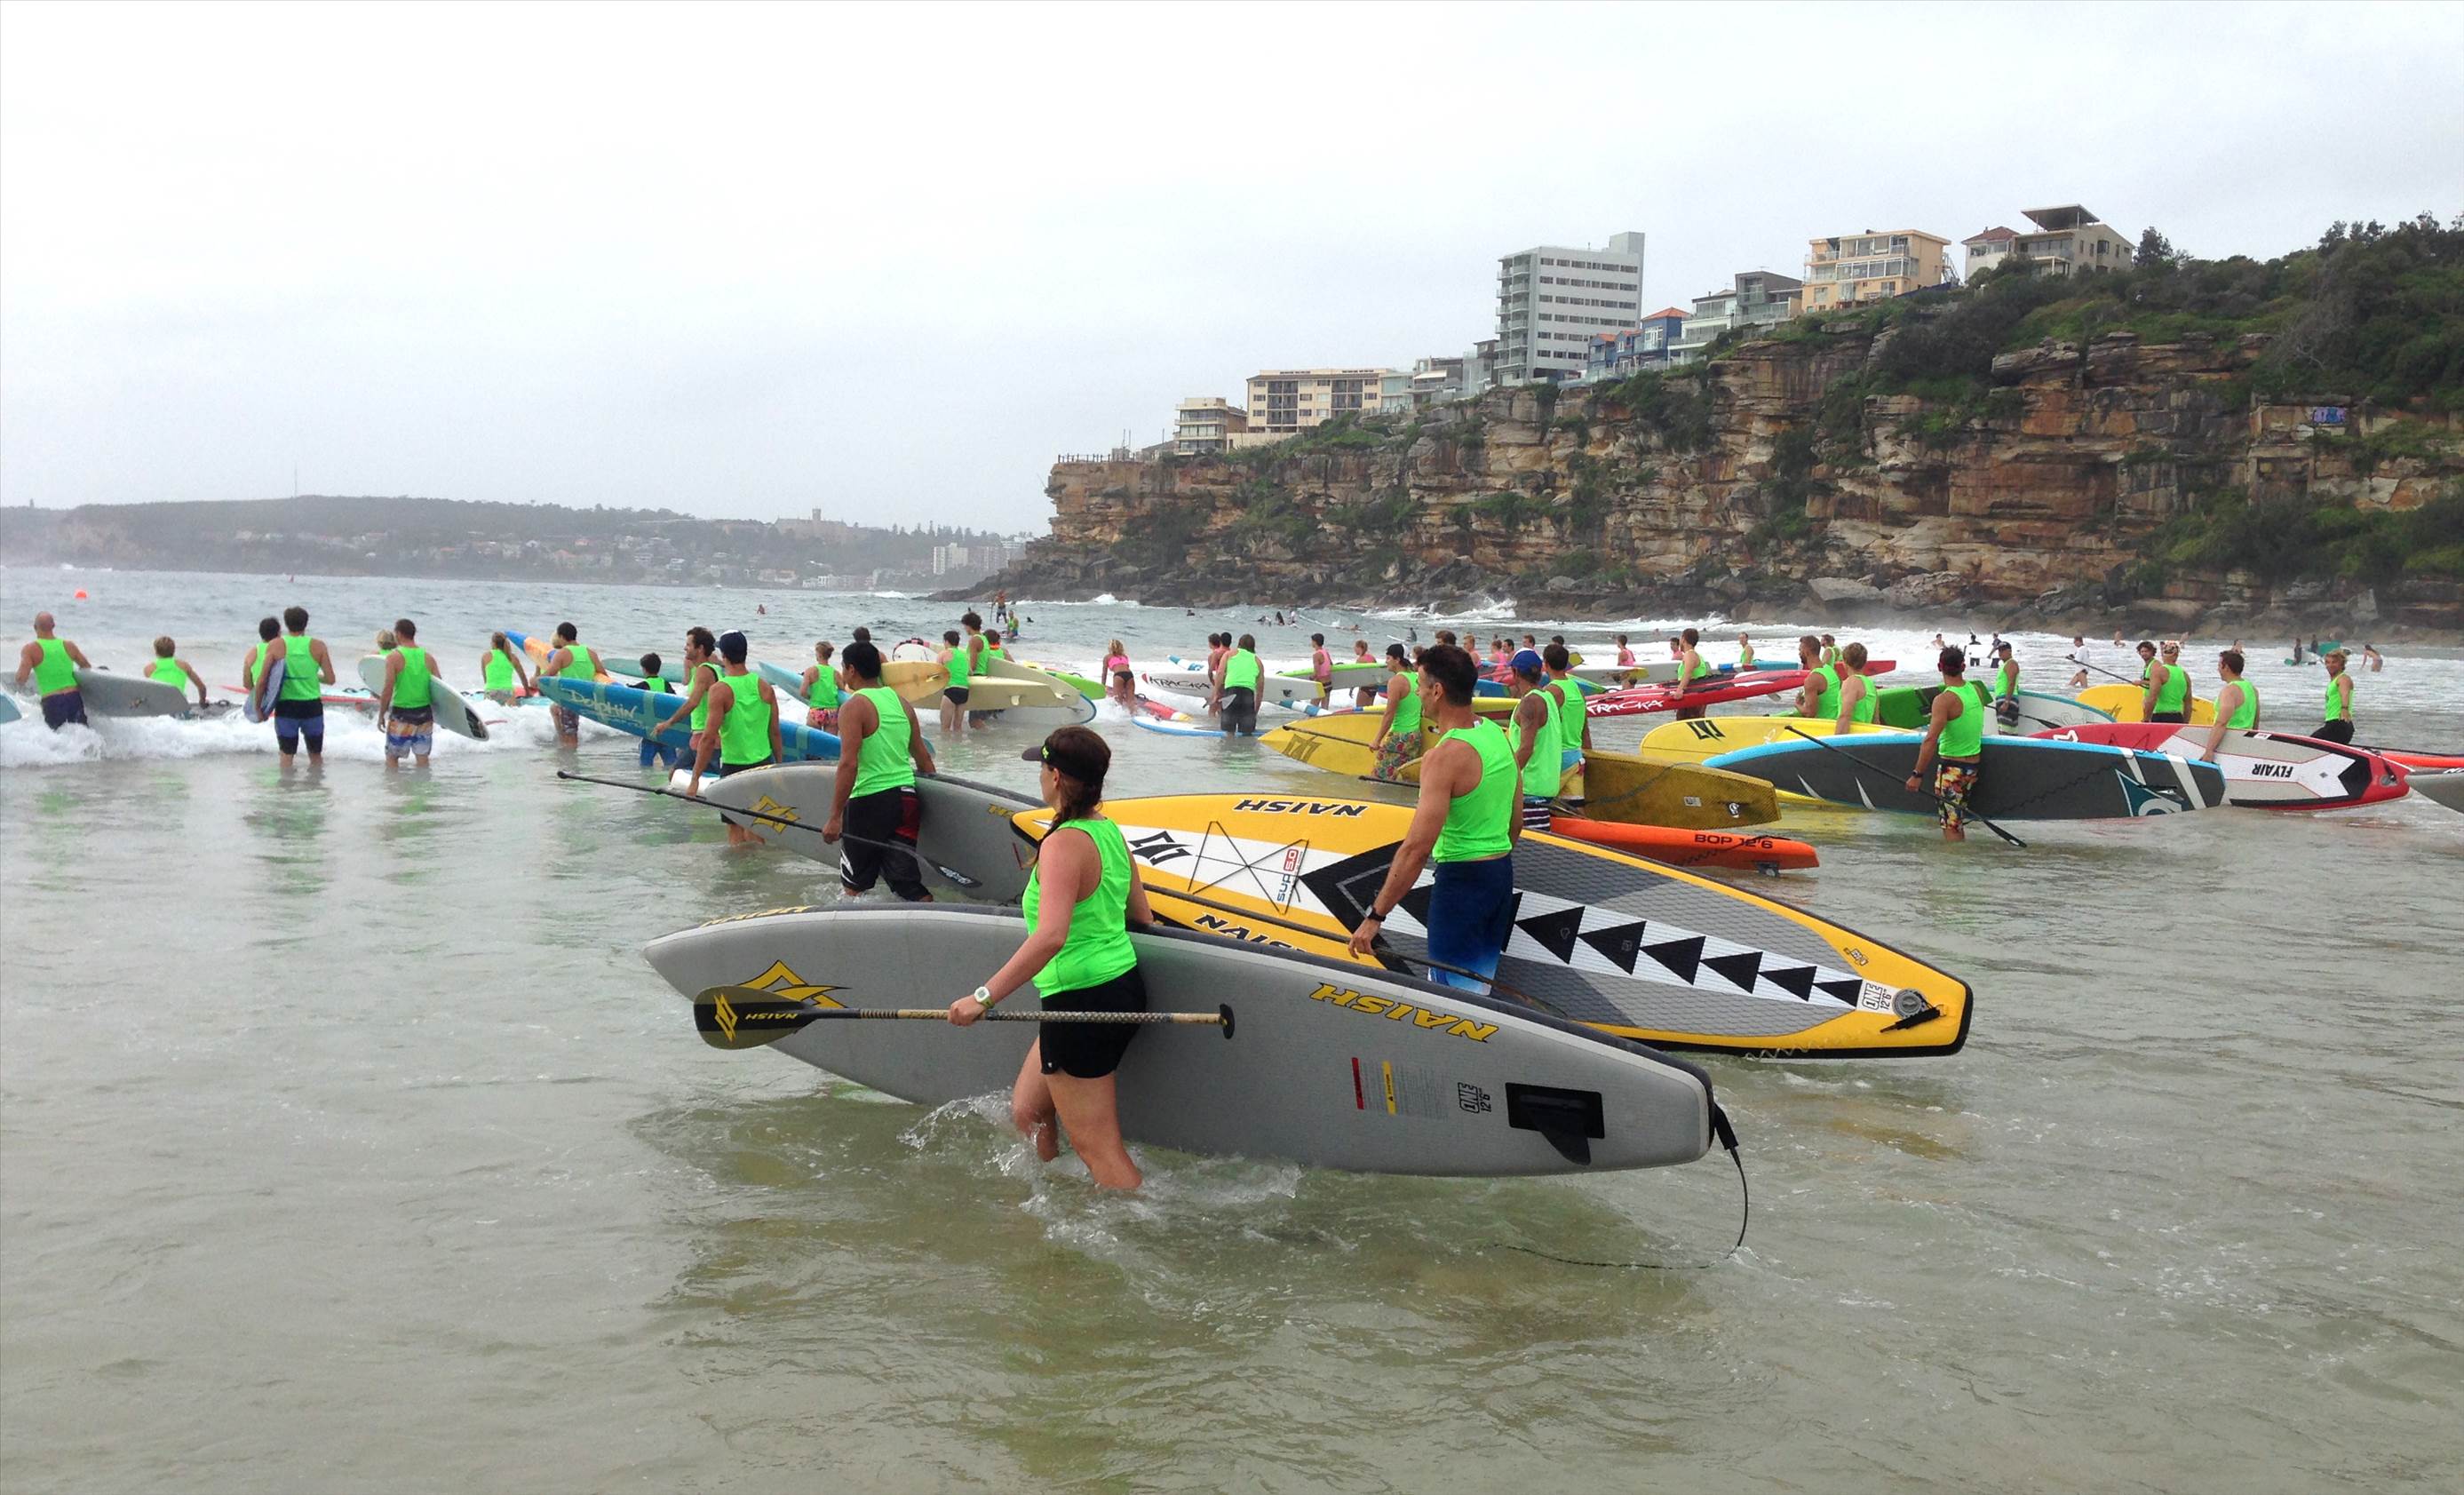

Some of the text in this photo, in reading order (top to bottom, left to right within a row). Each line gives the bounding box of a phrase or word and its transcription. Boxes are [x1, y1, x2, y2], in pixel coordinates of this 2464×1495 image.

[1232, 799, 1369, 817] NAISH
[1694, 834, 1733, 845] BOP
[1276, 849, 1299, 902] SUP 5.0
[1193, 913, 1307, 952] NAI
[744, 1012, 799, 1021] NAISH
[1309, 982, 1500, 1044] NAISH
